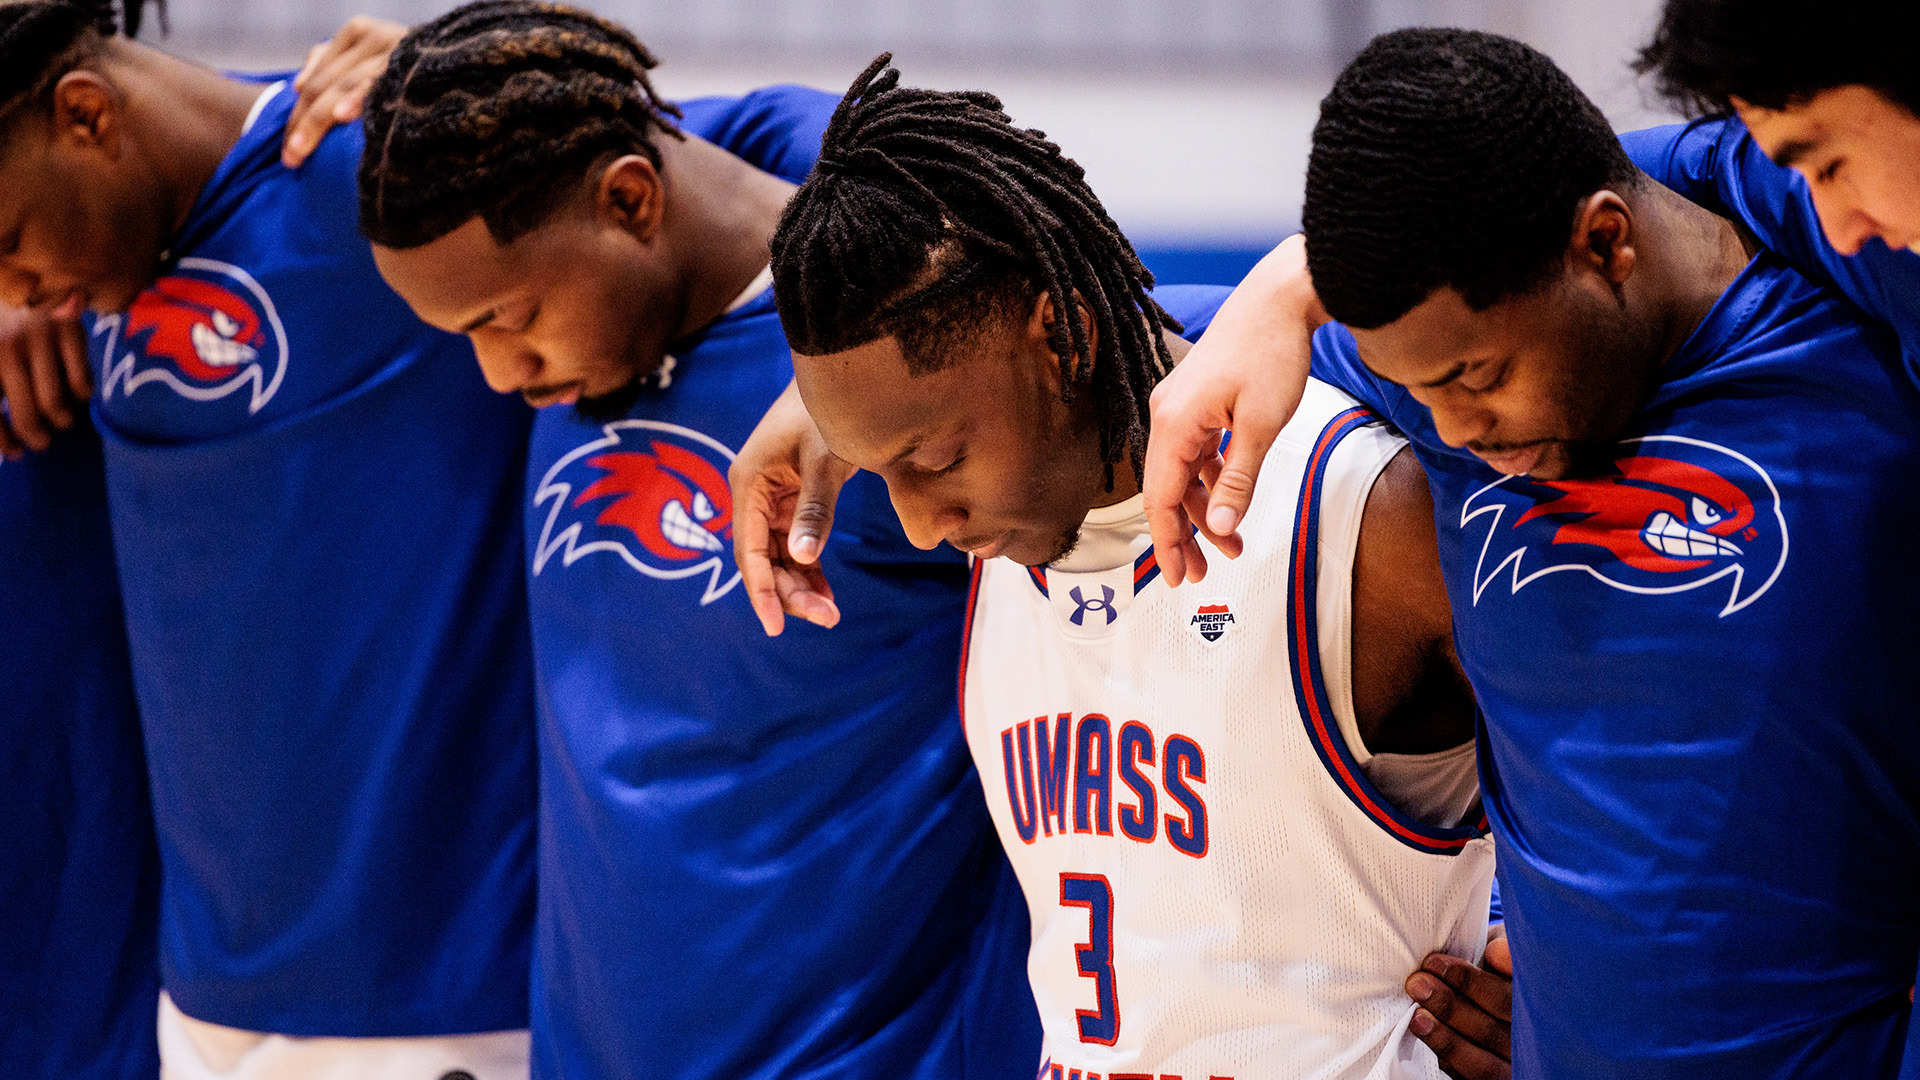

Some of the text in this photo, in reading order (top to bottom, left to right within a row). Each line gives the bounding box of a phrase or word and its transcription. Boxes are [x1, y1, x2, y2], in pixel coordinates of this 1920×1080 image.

[1190, 613, 1235, 626] AMERICA
[1200, 622, 1225, 631] EAST
[1001, 711, 1209, 859] UMASS
[1059, 872, 1120, 1047] 3
